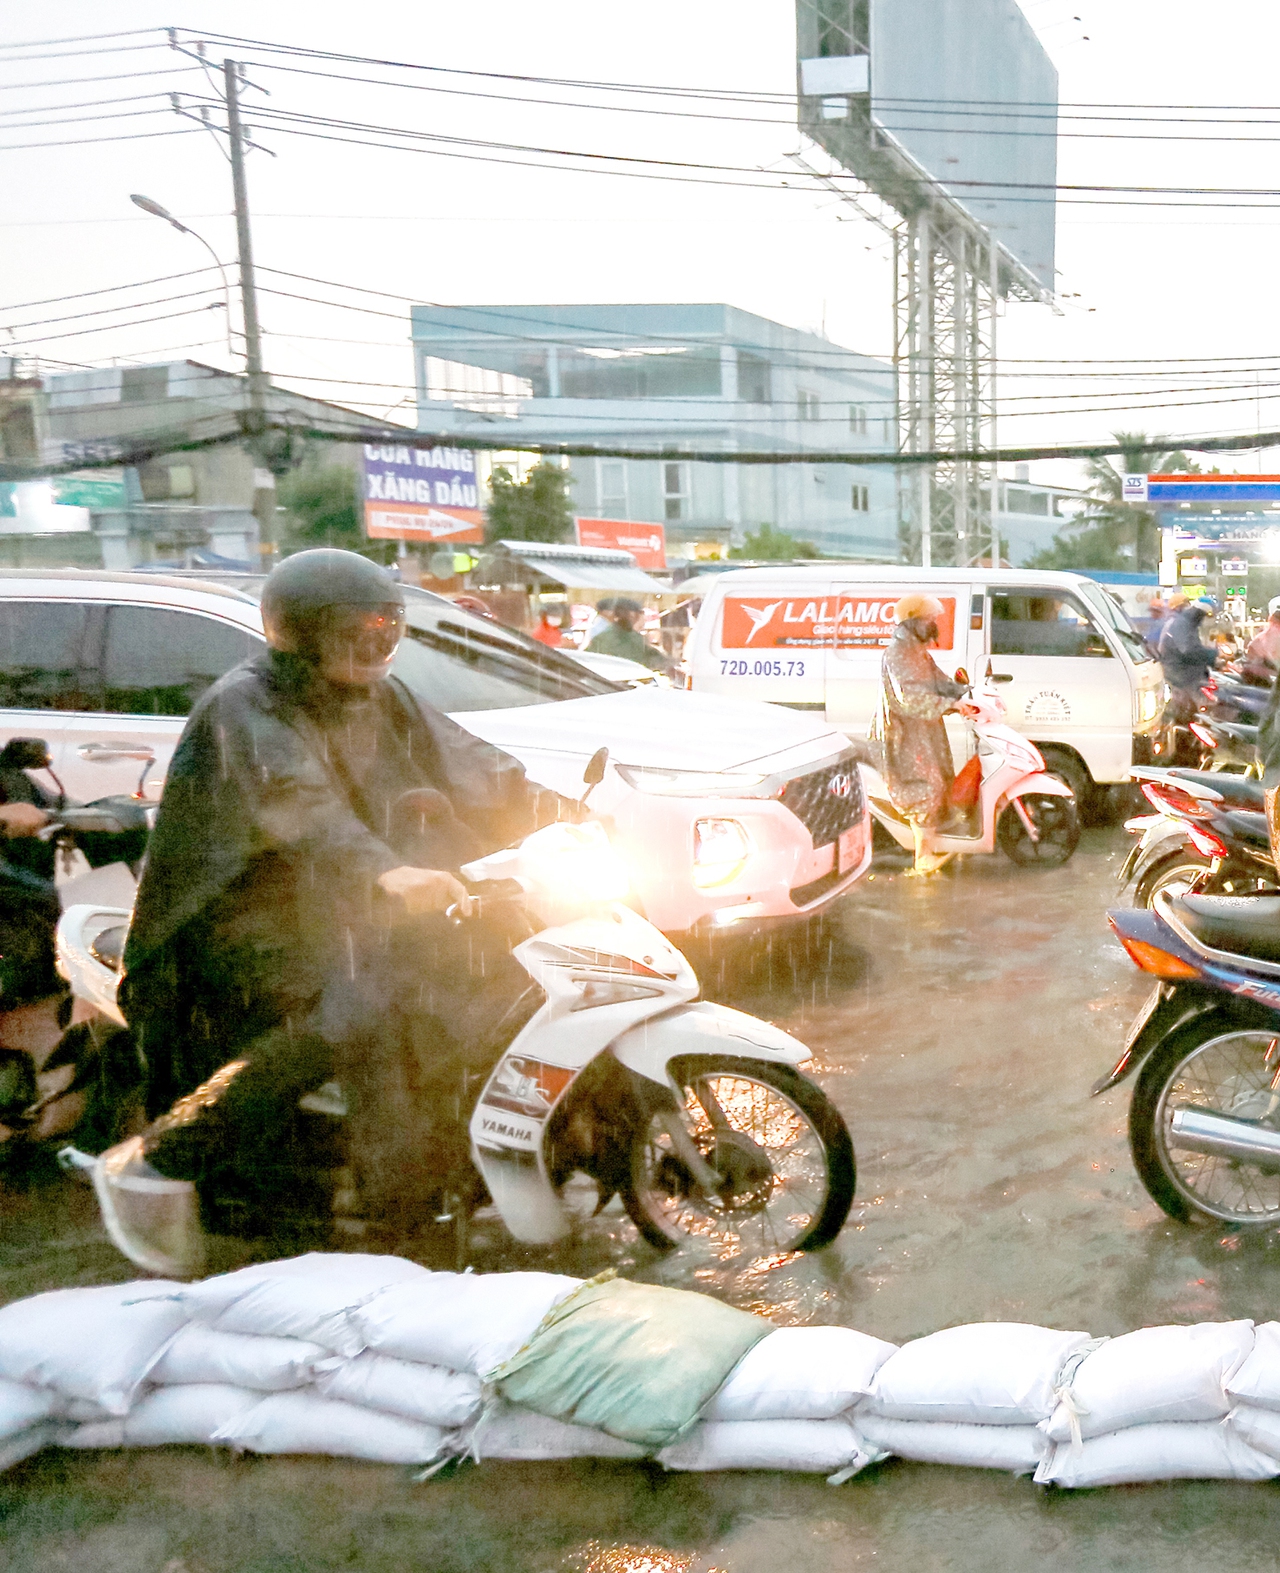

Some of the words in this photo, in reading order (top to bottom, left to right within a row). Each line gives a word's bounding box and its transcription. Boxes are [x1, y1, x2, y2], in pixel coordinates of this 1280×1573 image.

[367, 470, 431, 503] XĂNG
[783, 602, 901, 623] LALAMO
[720, 660, 805, 676] 72D.005.73
[482, 1117, 533, 1142] YAMAHA
